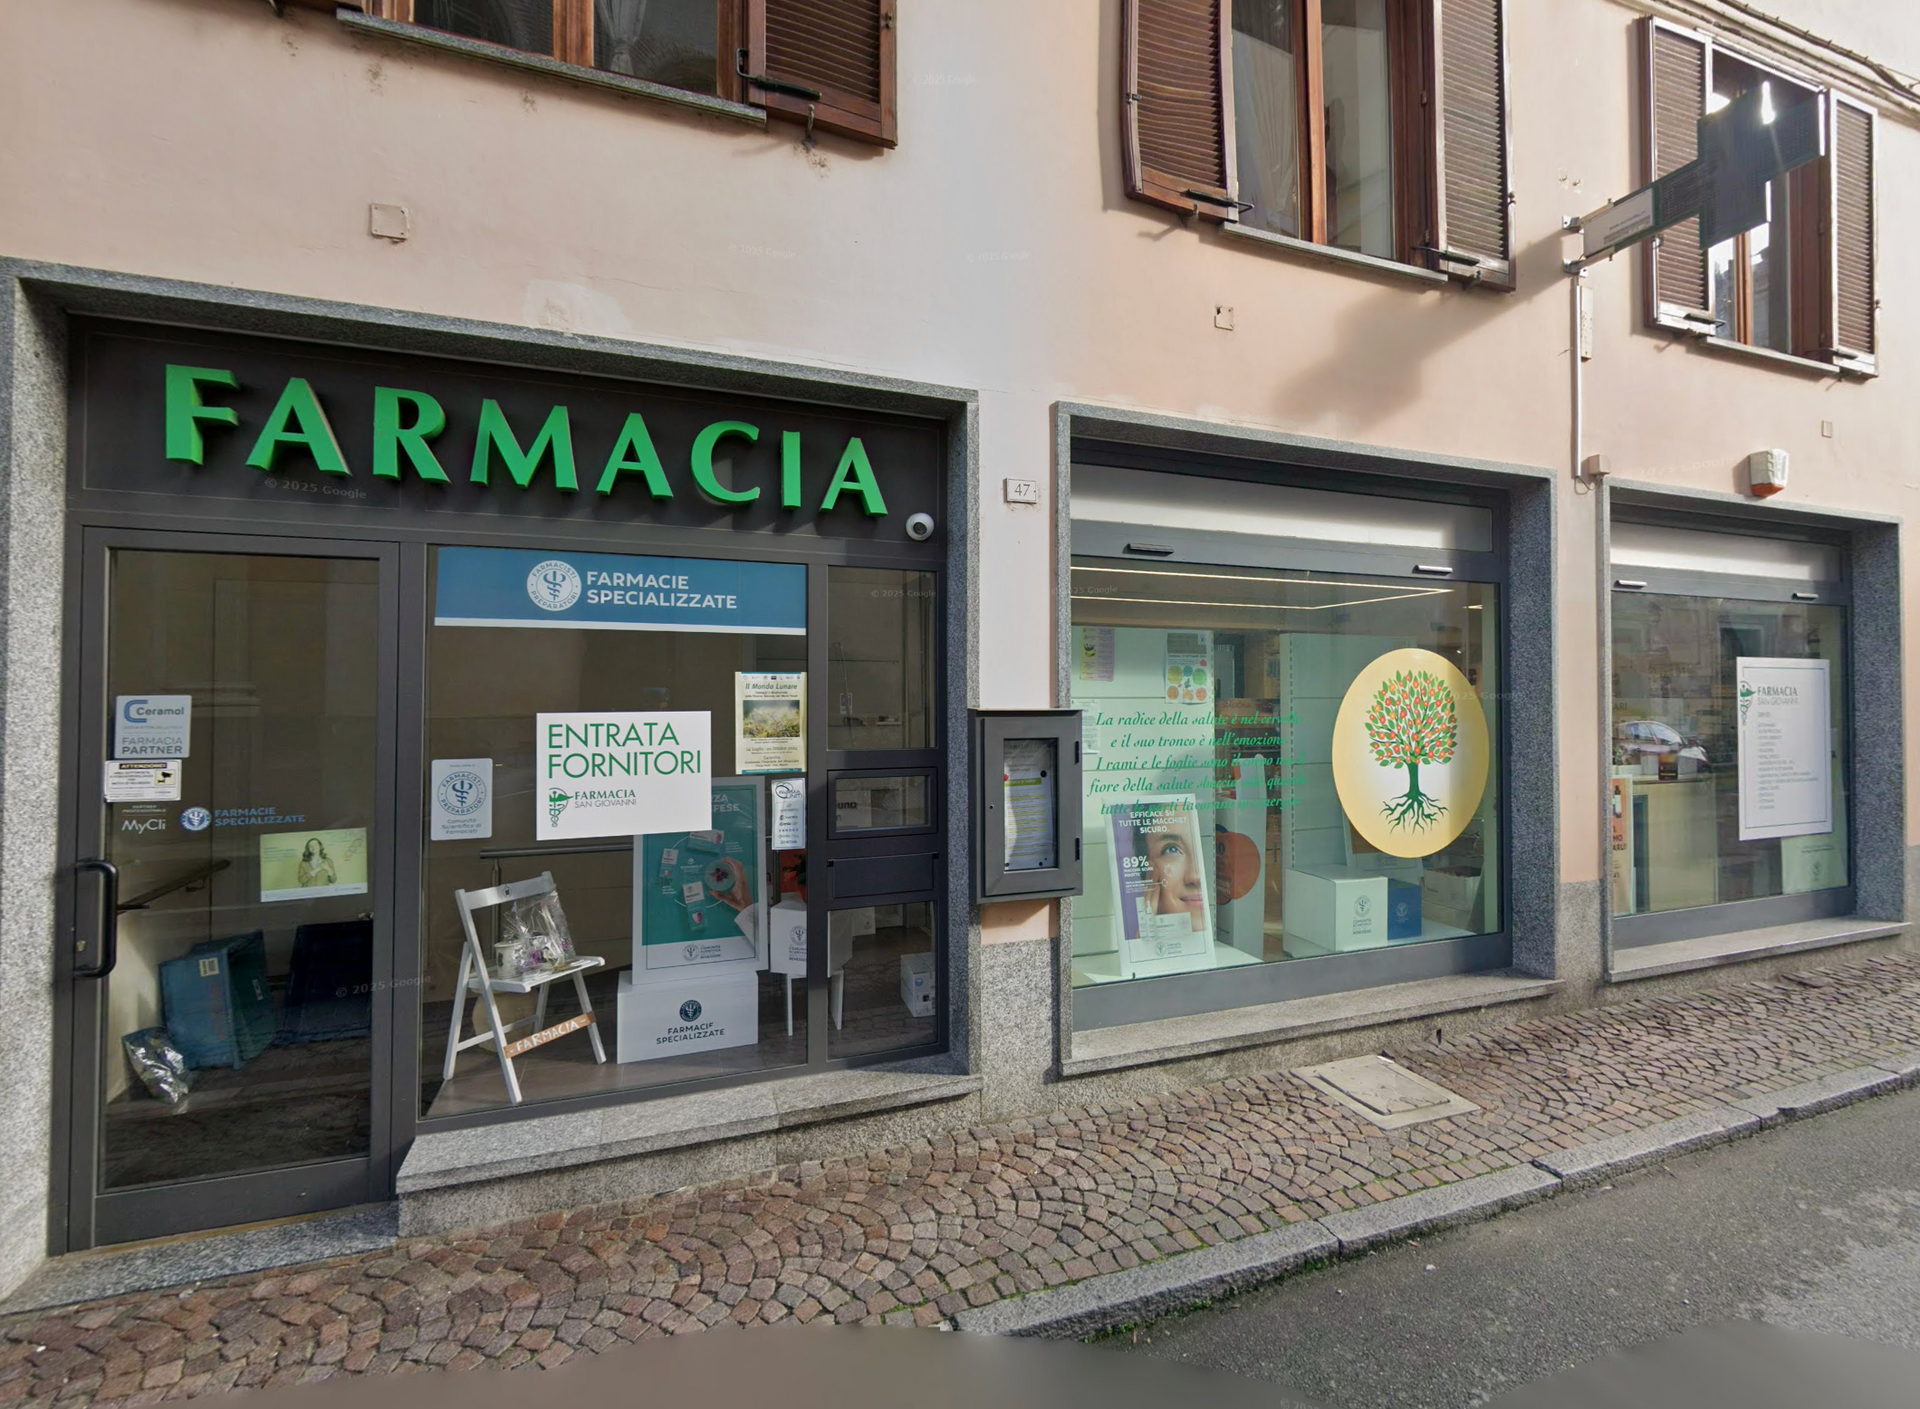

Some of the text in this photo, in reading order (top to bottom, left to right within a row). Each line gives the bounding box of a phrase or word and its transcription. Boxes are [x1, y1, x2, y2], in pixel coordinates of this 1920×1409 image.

[165, 363, 888, 517] FARMACIA
[1014, 483, 1031, 496] 47
[532, 561, 577, 580] FARMACISTI
[586, 571, 689, 590] FARMACIE
[531, 590, 578, 609] PREPARATORI
[586, 589, 737, 609] SPECIALIZZATE
[1757, 686, 1798, 696] FARMACIA
[136, 706, 185, 716] Ceramol
[1096, 712, 1113, 726] La
[1118, 711, 1156, 725] radice
[1159, 711, 1188, 725] della
[1192, 711, 1228, 725] salute
[1240, 710, 1259, 725] nel
[122, 737, 183, 746] FARMACIA
[549, 722, 680, 748] ENTRATA
[1111, 739, 1118, 748] e
[1121, 733, 1132, 748] il
[1134, 739, 1155, 747] suo
[1158, 736, 1196, 747] tronco
[1199, 734, 1205, 746] è
[122, 745, 183, 755] PARTNER
[549, 750, 701, 779] FORNITORI
[1096, 757, 1103, 770] I
[1106, 756, 1138, 770] rami
[1141, 760, 1148, 769] e
[1151, 755, 1162, 769] le
[1162, 754, 1198, 772] foglie
[442, 773, 482, 788] FARMACISTI
[1086, 778, 1120, 797] fiore
[1122, 777, 1153, 792] della
[1156, 776, 1194, 791] salute
[574, 789, 636, 801] FARMACIA
[441, 797, 483, 814] PREPARATORI
[574, 798, 637, 809] SAN GIOVANNI
[713, 803, 740, 812] FESE
[1100, 803, 1130, 815] tutte
[214, 807, 276, 817] FARMACIE
[122, 818, 166, 834] MyCli
[214, 815, 305, 826] SPECIALIZZATE
[1118, 819, 1141, 827] TUTTE
[1142, 818, 1151, 826] LE
[1123, 855, 1149, 868] 89%
[516, 1020, 579, 1052] FARMACIA
[656, 1028, 725, 1045] SPECIALIZZATE
